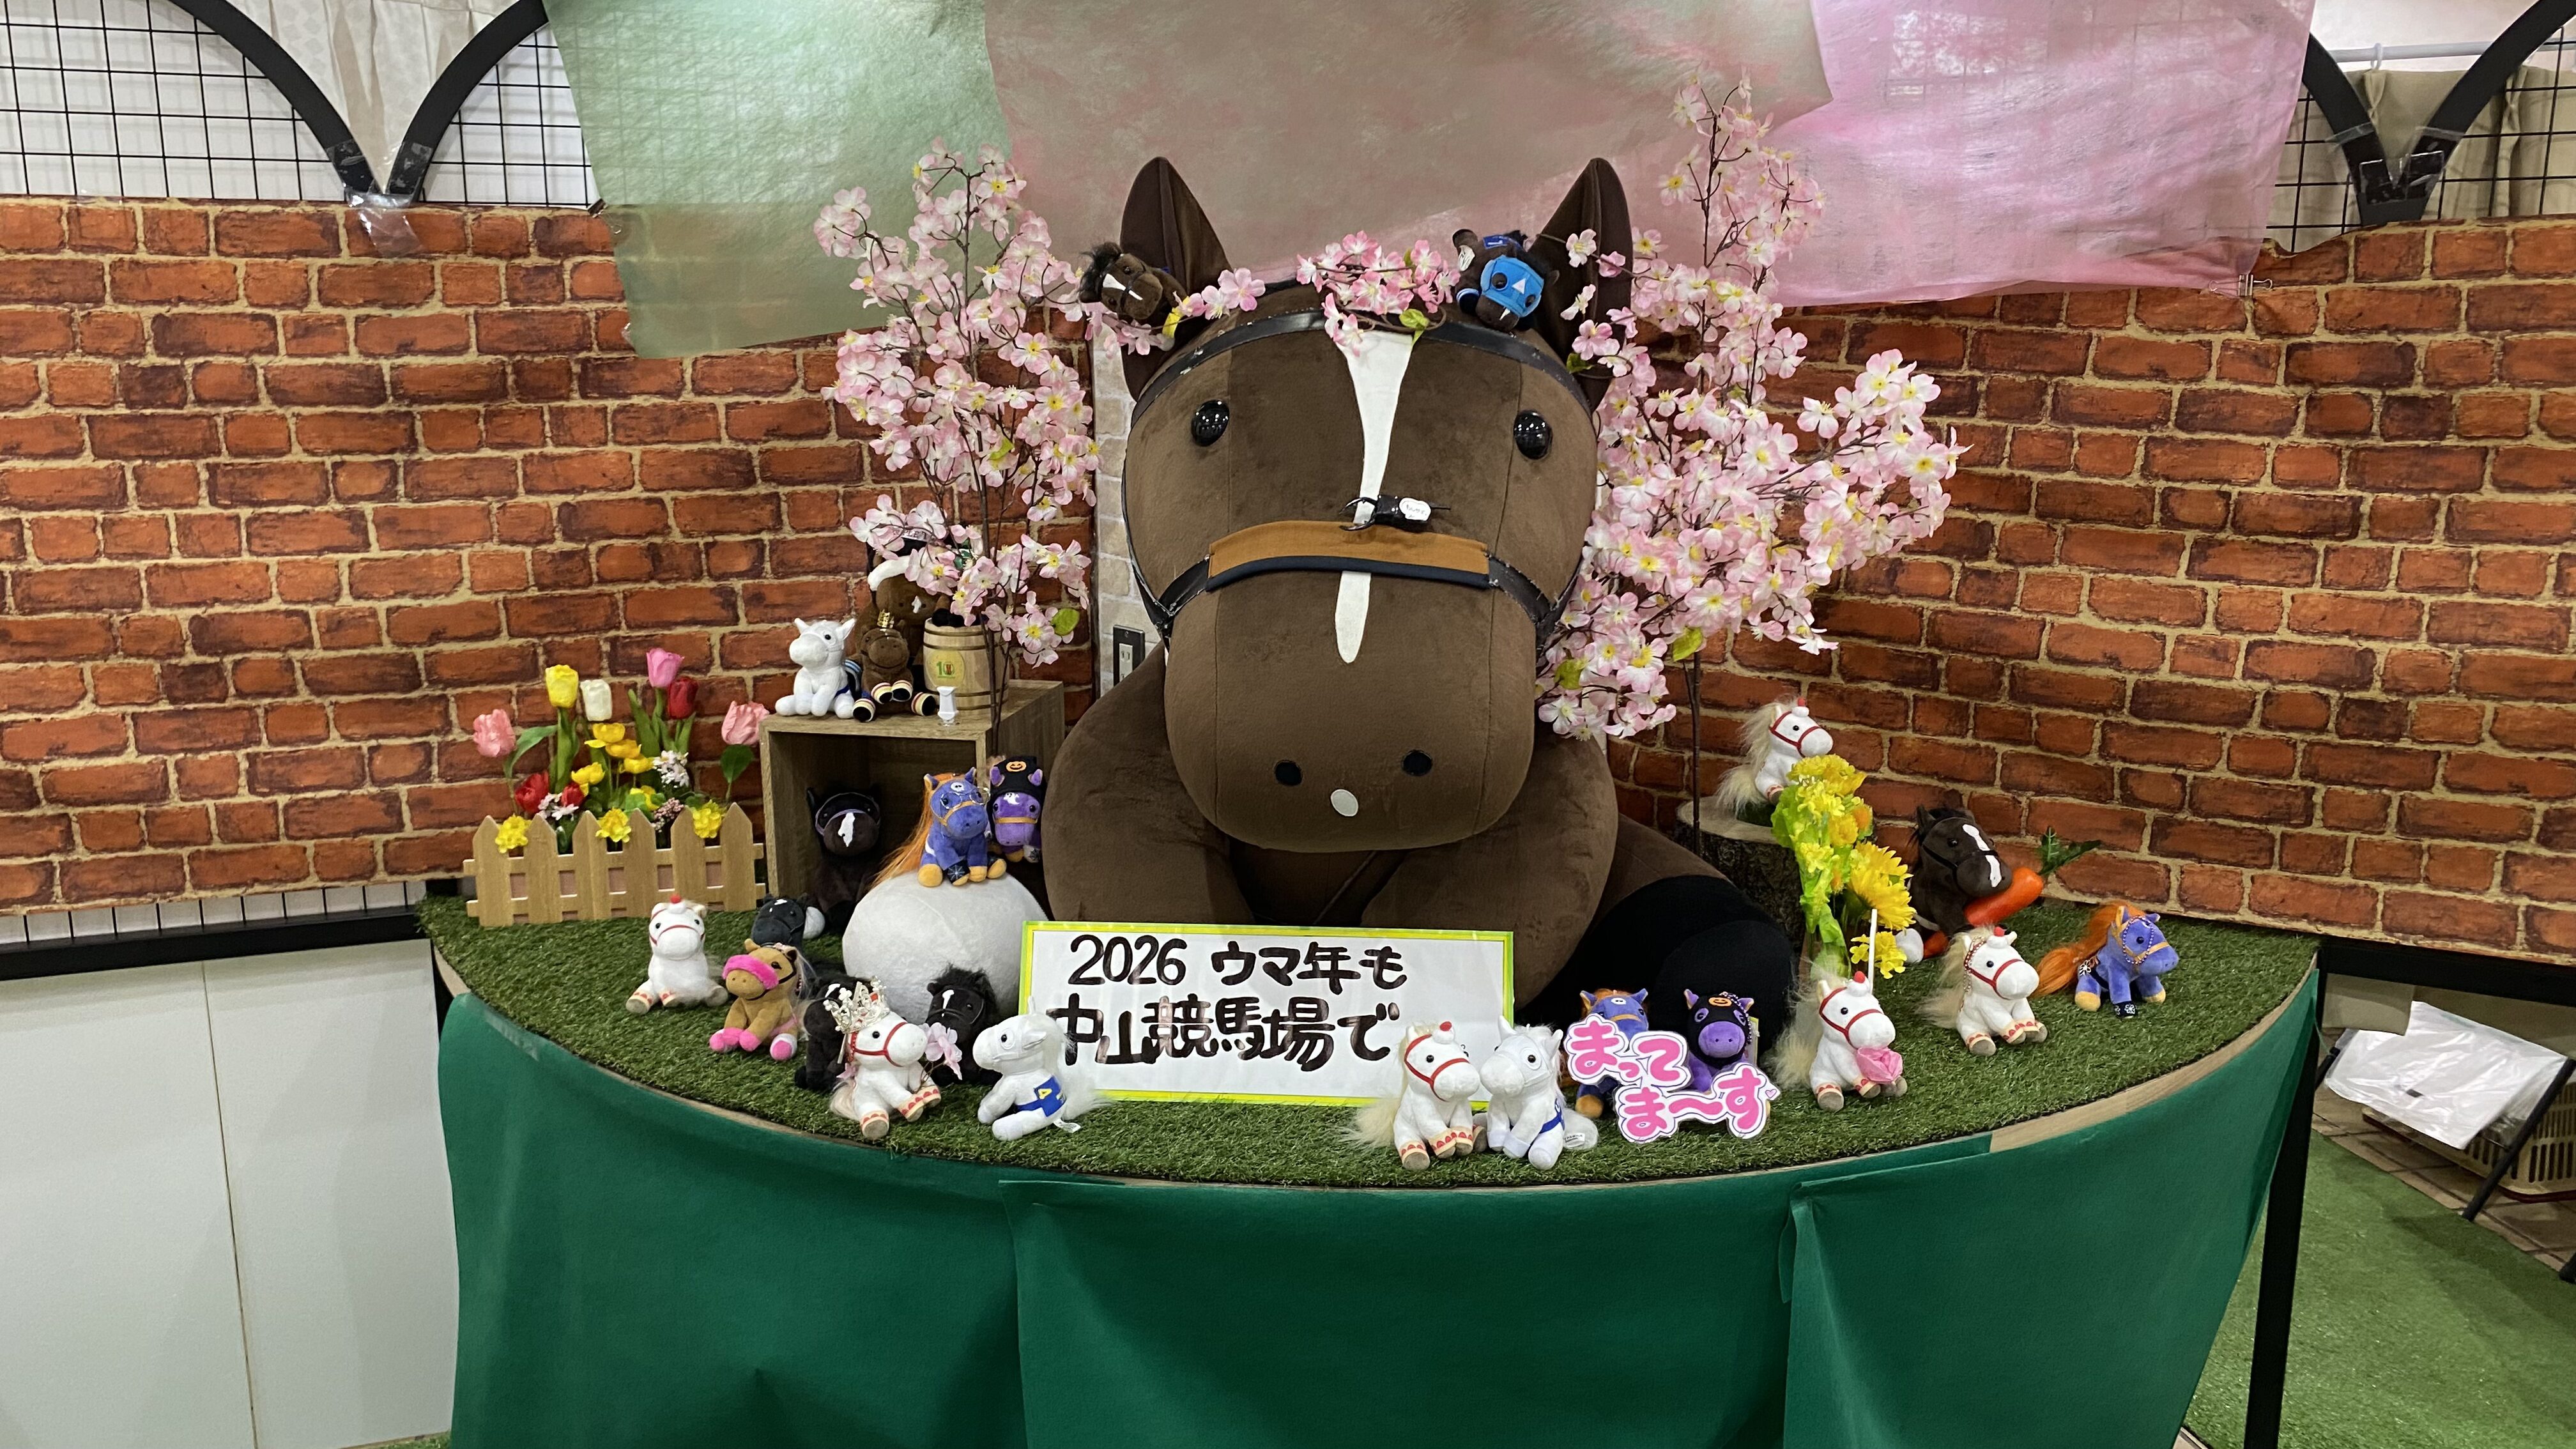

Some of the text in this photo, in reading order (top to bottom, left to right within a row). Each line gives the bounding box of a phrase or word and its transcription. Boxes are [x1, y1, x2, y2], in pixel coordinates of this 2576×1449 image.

[1068, 934, 1407, 995] 2026 ウマ年も
[1046, 993, 1401, 1071] 中山競馬場で
[1570, 1020, 1681, 1082] まって
